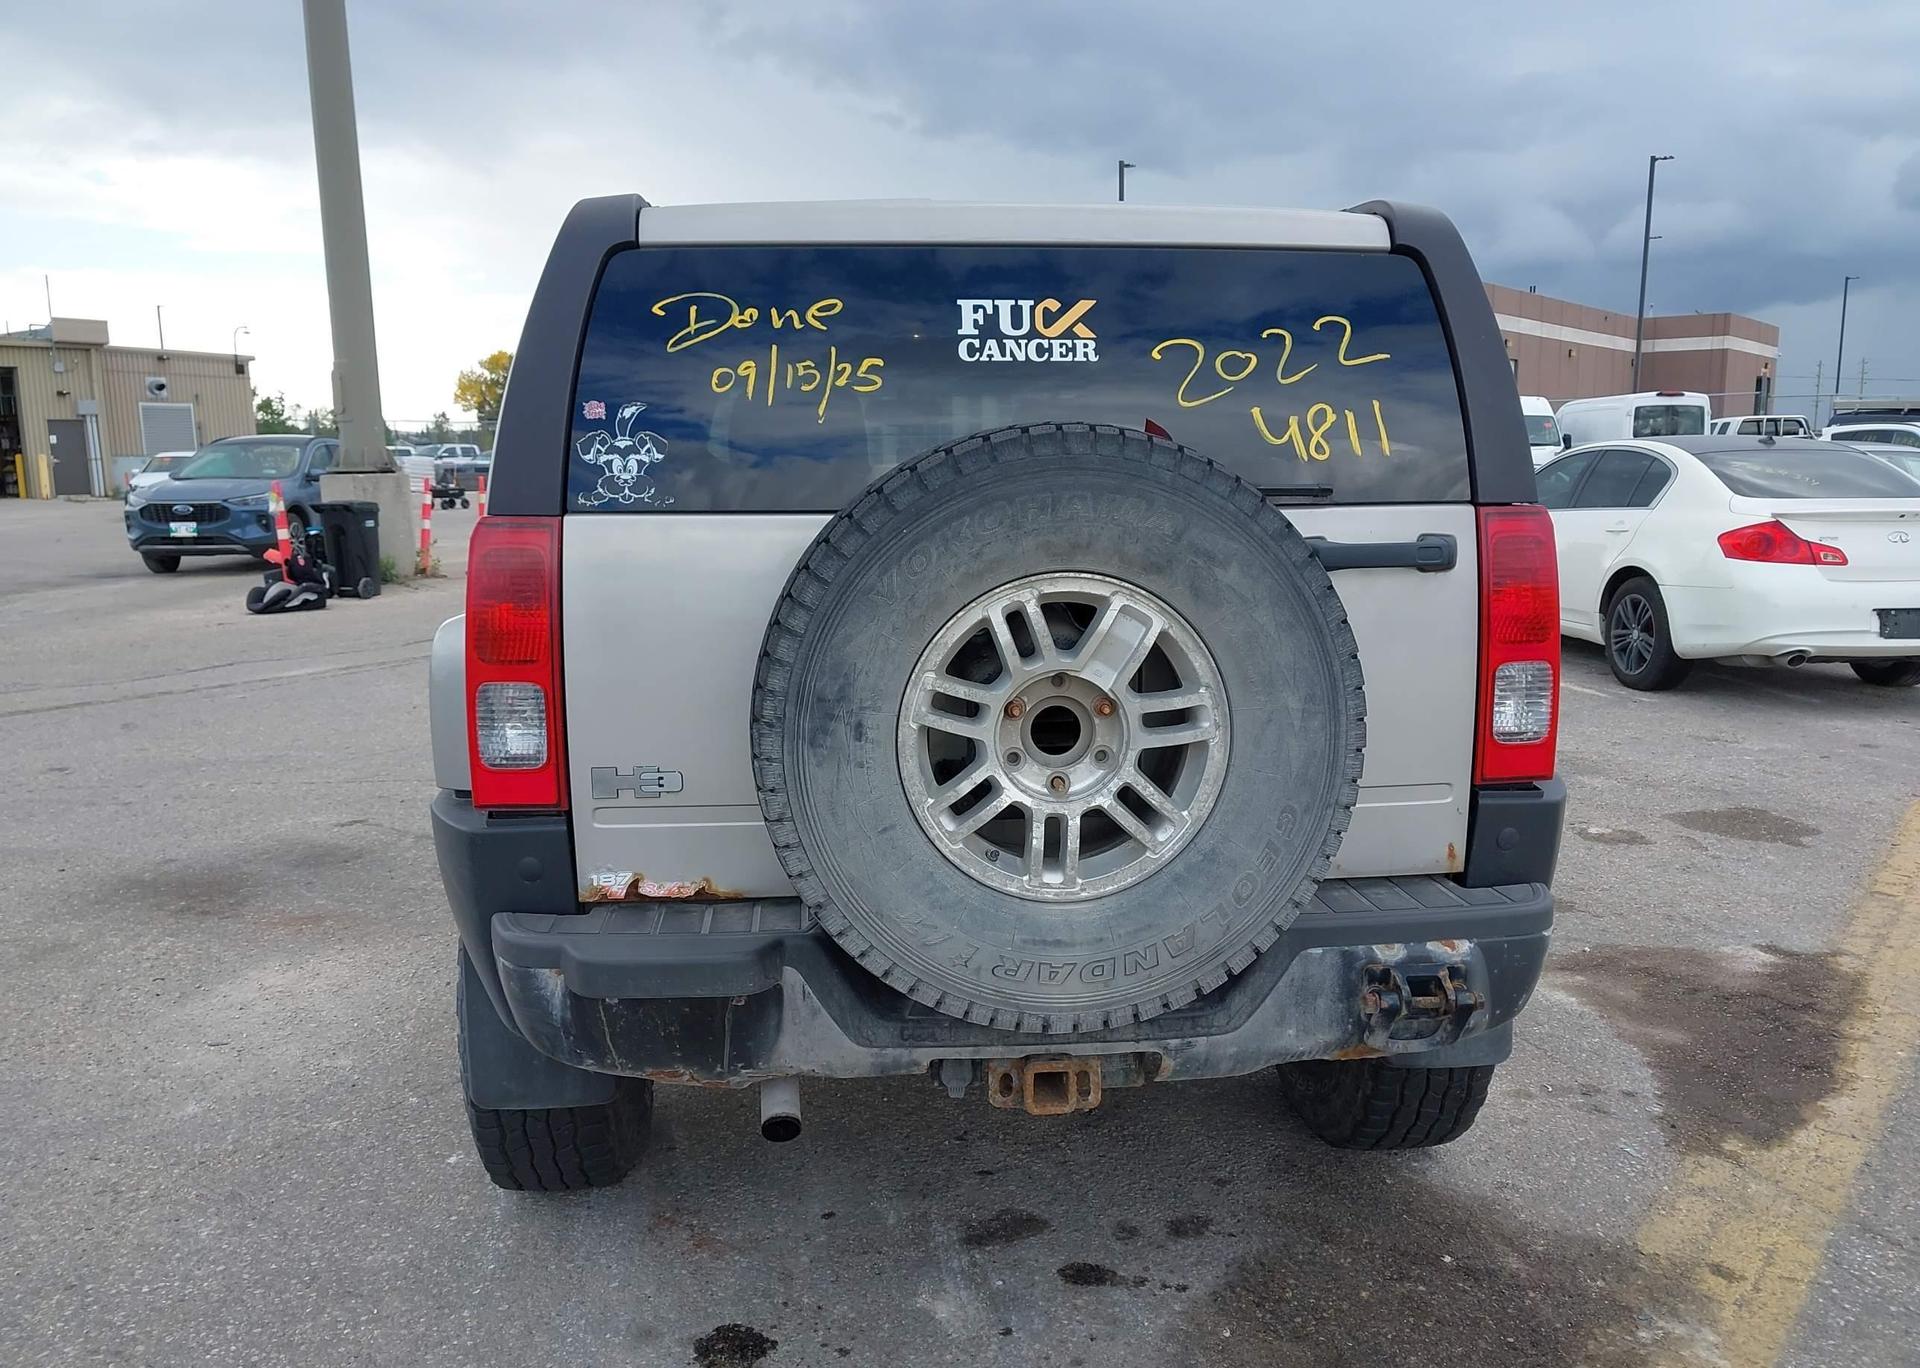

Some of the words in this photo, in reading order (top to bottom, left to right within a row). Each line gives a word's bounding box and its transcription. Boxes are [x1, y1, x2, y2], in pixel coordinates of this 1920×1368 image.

[652, 292, 844, 353] Done
[957, 338, 1099, 363] CANCER
[711, 343, 885, 424] 09/15/25
[1151, 315, 1391, 408] 2022
[1251, 399, 1391, 463] 4811
[590, 871, 633, 891] 187
[992, 804, 1299, 986] GEOLANDAR
